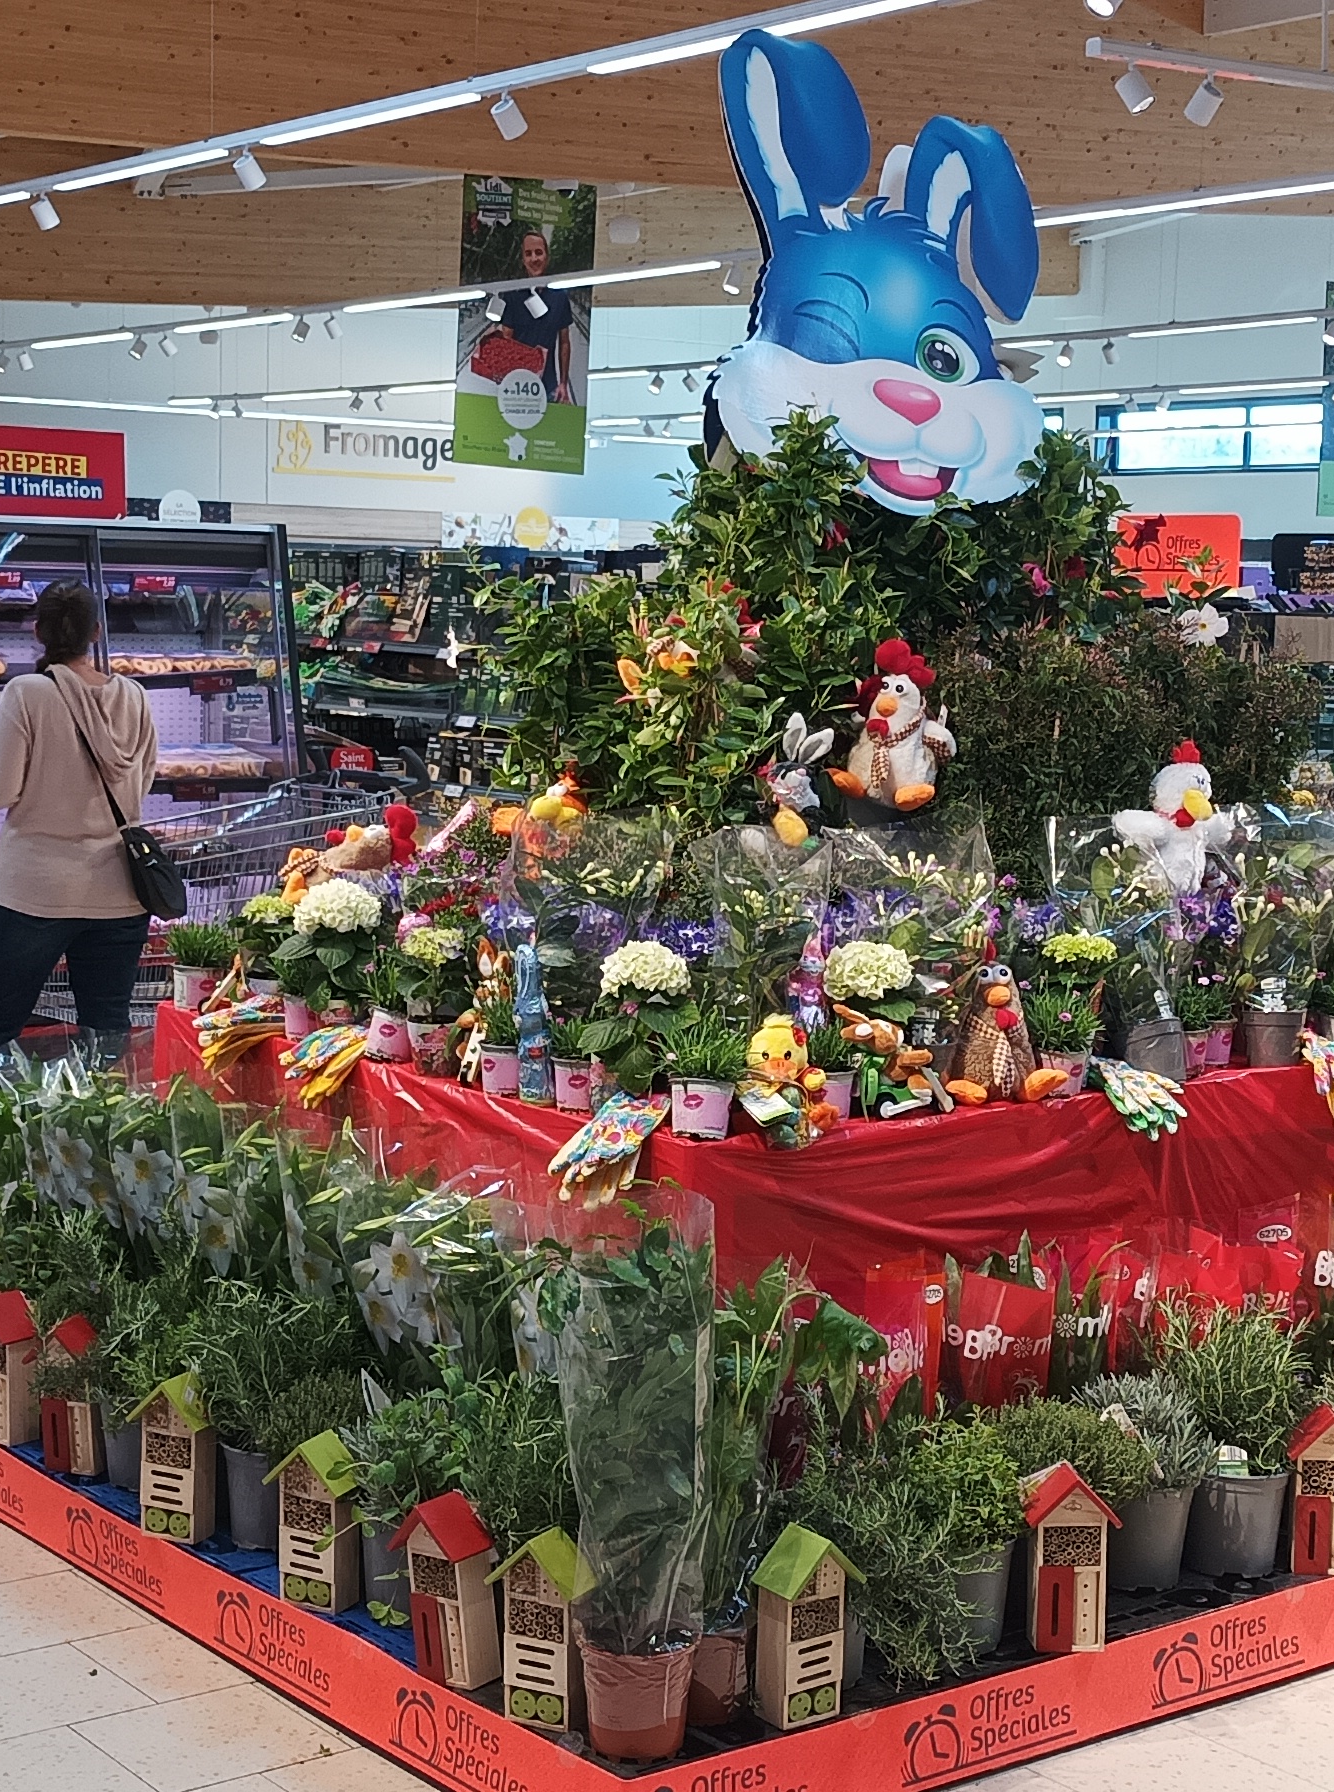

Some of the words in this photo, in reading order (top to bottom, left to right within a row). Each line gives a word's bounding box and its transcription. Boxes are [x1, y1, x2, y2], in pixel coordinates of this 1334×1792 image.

[476, 193, 512, 204] SOUTIENT
[515, 381, 540, 396] 140
[323, 424, 454, 471] Fromage
[8, 476, 103, 501] l'inflation
[1166, 535, 1201, 552] Offres
[339, 750, 366, 763] Saint
[1258, 1227, 1289, 1239] 62705
[99, 1517, 140, 1558] Offres
[101, 1546, 164, 1598] Spéciales
[258, 1602, 307, 1648] Offres
[1210, 1613, 1268, 1653] Offres
[258, 1635, 331, 1694] Spéciales
[1210, 1634, 1301, 1679] Spéciales
[969, 1682, 1035, 1723] Offres
[445, 1705, 501, 1756] Offres
[969, 1703, 1071, 1755] Spéciales
[691, 1763, 767, 1792] Offres
